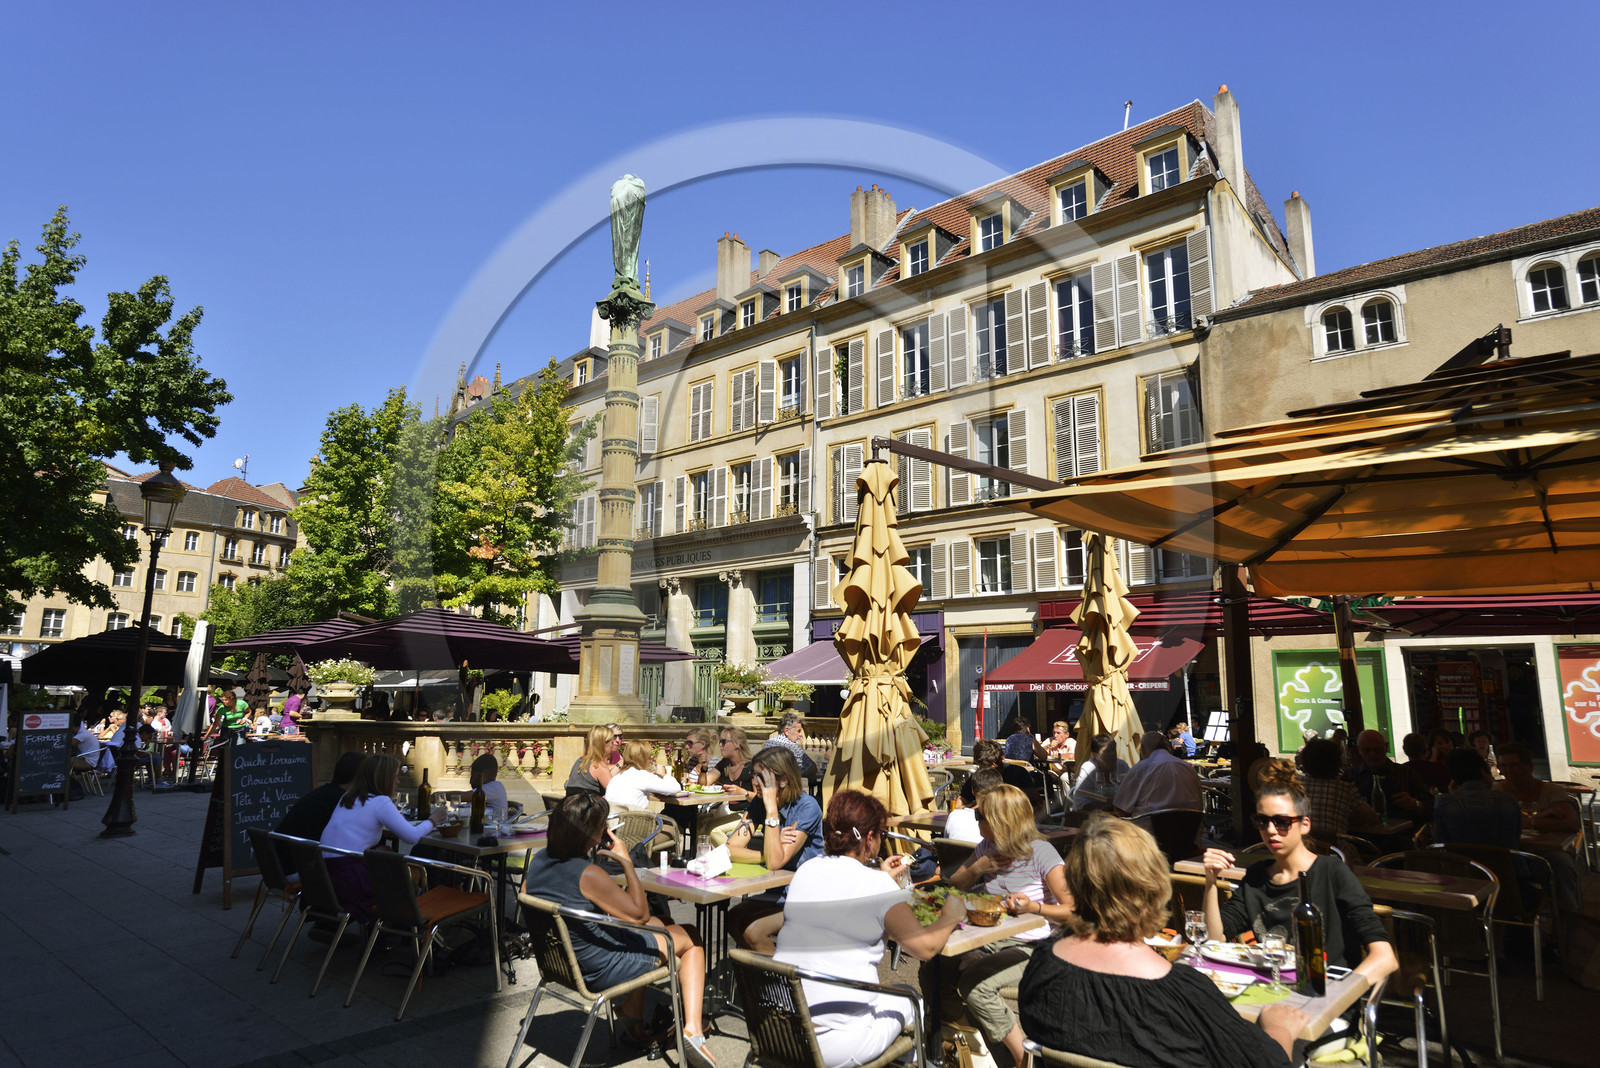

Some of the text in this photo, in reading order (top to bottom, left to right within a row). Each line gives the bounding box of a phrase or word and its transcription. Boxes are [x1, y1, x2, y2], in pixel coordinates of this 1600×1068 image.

[666, 550, 712, 566] PUBLIQUES
[1029, 683, 1044, 691] Diet
[1045, 683, 1053, 691] &
[25, 734, 62, 744] FORMULE
[234, 753, 266, 769] Quiche
[240, 770, 294, 787] Choucroute
[259, 791, 272, 803] de
[275, 788, 301, 801] Veau
[234, 808, 266, 825] Jarret
[270, 807, 281, 819] de
